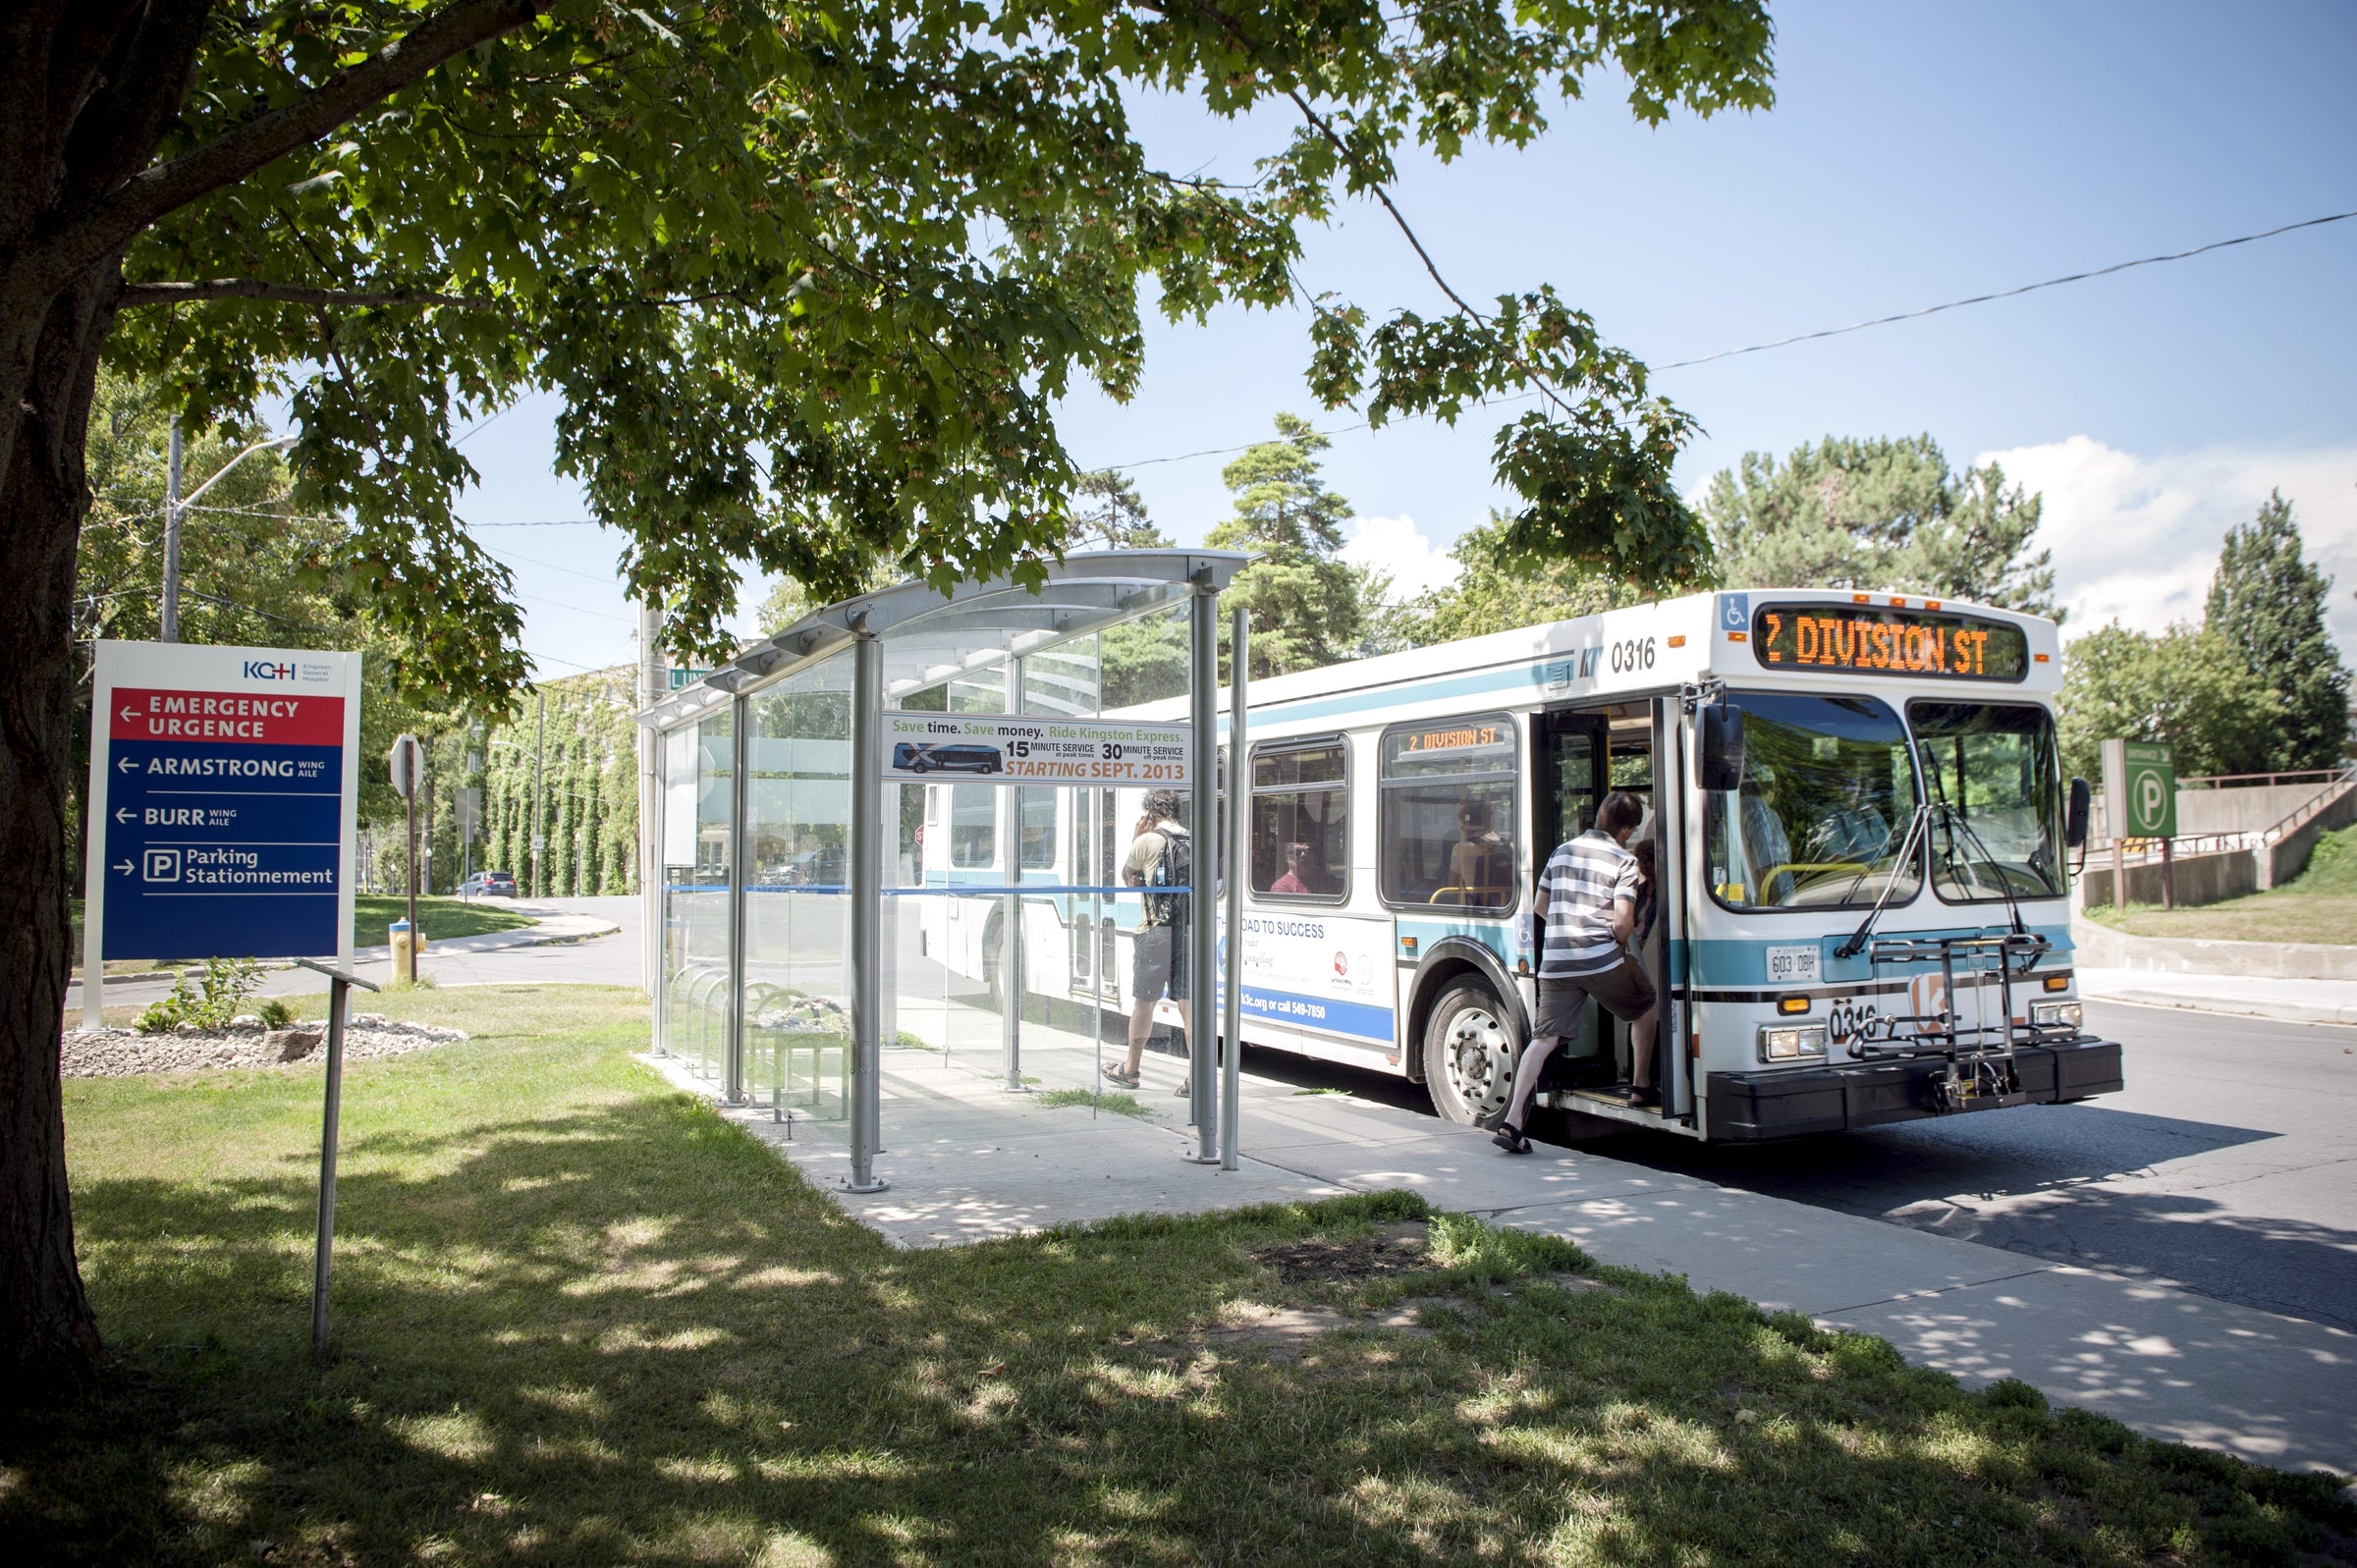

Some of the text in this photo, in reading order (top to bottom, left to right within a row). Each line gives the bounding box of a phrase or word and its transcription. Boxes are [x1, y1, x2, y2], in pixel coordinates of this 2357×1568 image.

[1612, 636, 1656, 674] 0316
[1796, 617, 1946, 673] DIVISION
[1953, 629, 1989, 676] ST
[149, 696, 300, 718] EMERGENCY
[148, 719, 264, 737] URGENCE
[893, 720, 1183, 743] Save time. Save money. Ride Kingston Express.
[1007, 740, 1095, 758] 15 MINUTE SERVICE
[1409, 728, 1497, 751] 2 DIVISION ST
[1102, 743, 1184, 760] 30 MINUTE SERVICE
[147, 758, 325, 778] ARMSTRONG WING
[298, 769, 318, 778] AILE
[1006, 760, 1184, 780] STARTING SEPT. 2013
[2143, 779, 2163, 823] P
[145, 808, 237, 826] BURR WING
[153, 856, 172, 877] P
[187, 848, 258, 868] Parking
[186, 868, 333, 884] Stationnement
[1241, 919, 1260, 933] OAD
[1262, 920, 1275, 935] TO
[1277, 921, 1325, 939] SUCCESS
[1269, 1000, 1278, 1011] or
[1278, 1000, 1291, 1013] call
[1291, 1001, 1326, 1020] 549-7850
[1830, 1004, 1877, 1039] 0316
